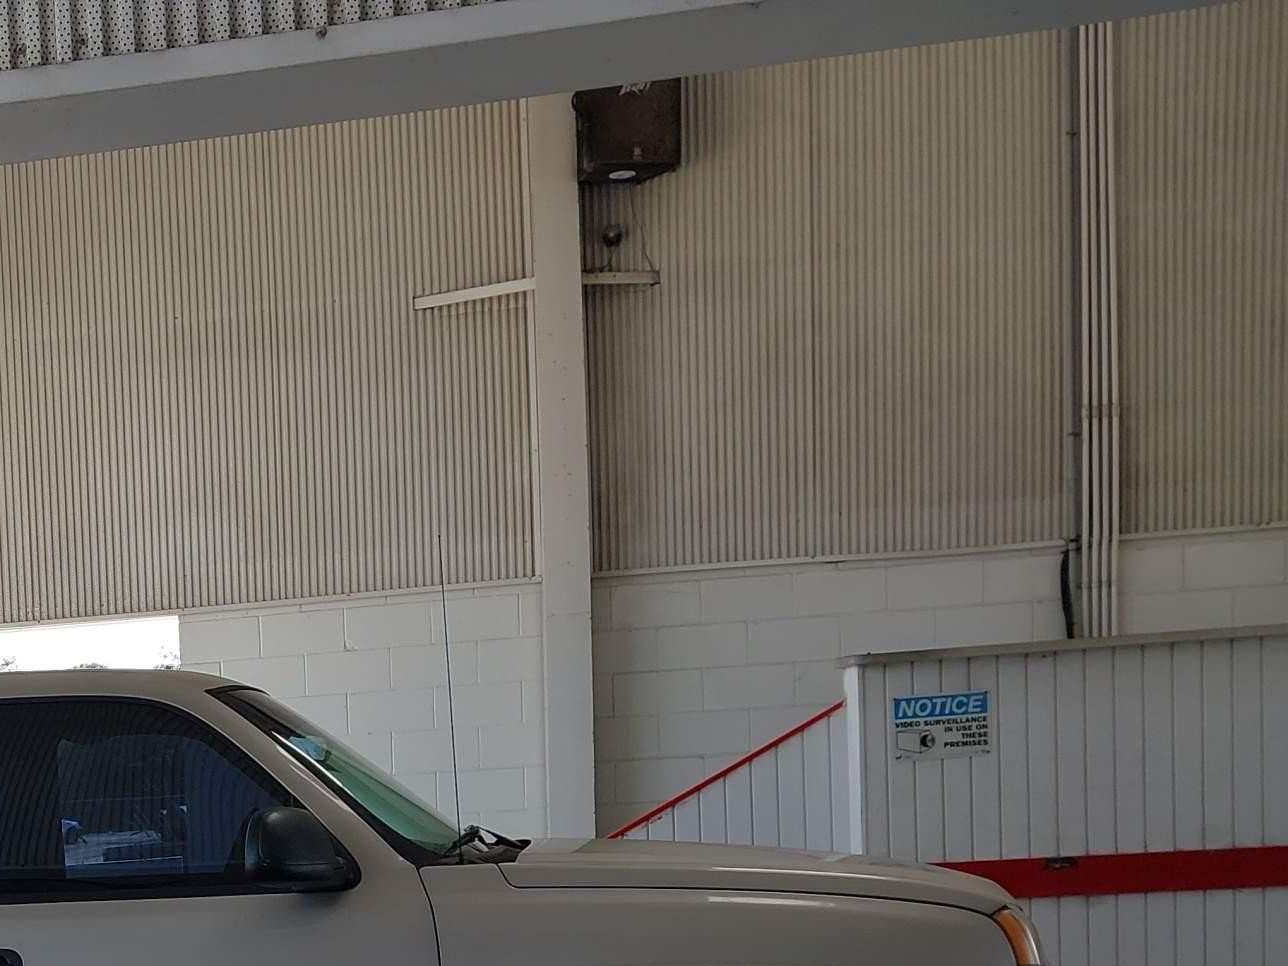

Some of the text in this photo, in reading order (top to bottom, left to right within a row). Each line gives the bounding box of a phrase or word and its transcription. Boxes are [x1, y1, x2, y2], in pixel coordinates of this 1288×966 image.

[898, 695, 984, 718] NOTICE
[895, 716, 988, 729] VIDEO SURVEILLANCE
[976, 723, 989, 731] ON
[961, 731, 989, 739] THESE
[943, 739, 989, 748] PREMISES
